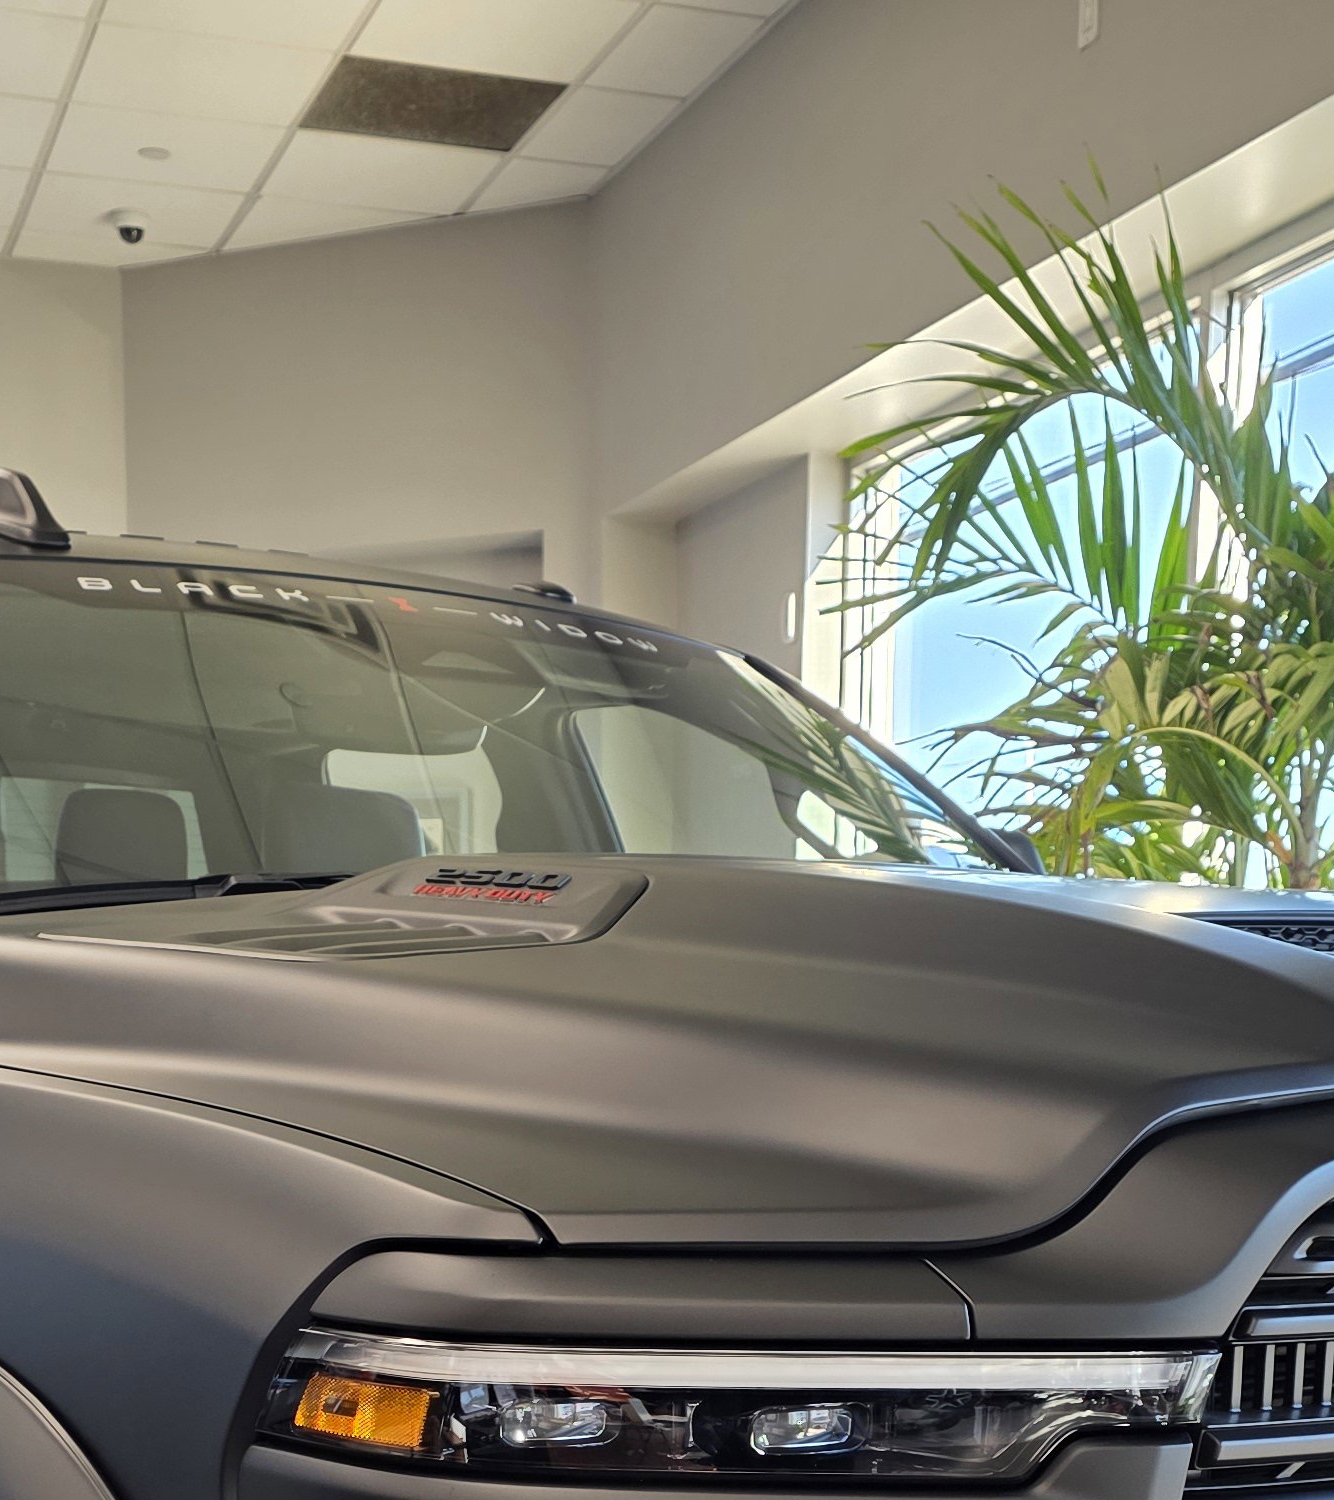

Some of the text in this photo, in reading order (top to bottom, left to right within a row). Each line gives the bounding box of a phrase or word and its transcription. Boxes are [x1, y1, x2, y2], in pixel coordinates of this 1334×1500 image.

[76, 576, 658, 652] BLACK WIDOW
[425, 868, 572, 891] 2500
[412, 883, 559, 904] HEAVY DUTY
